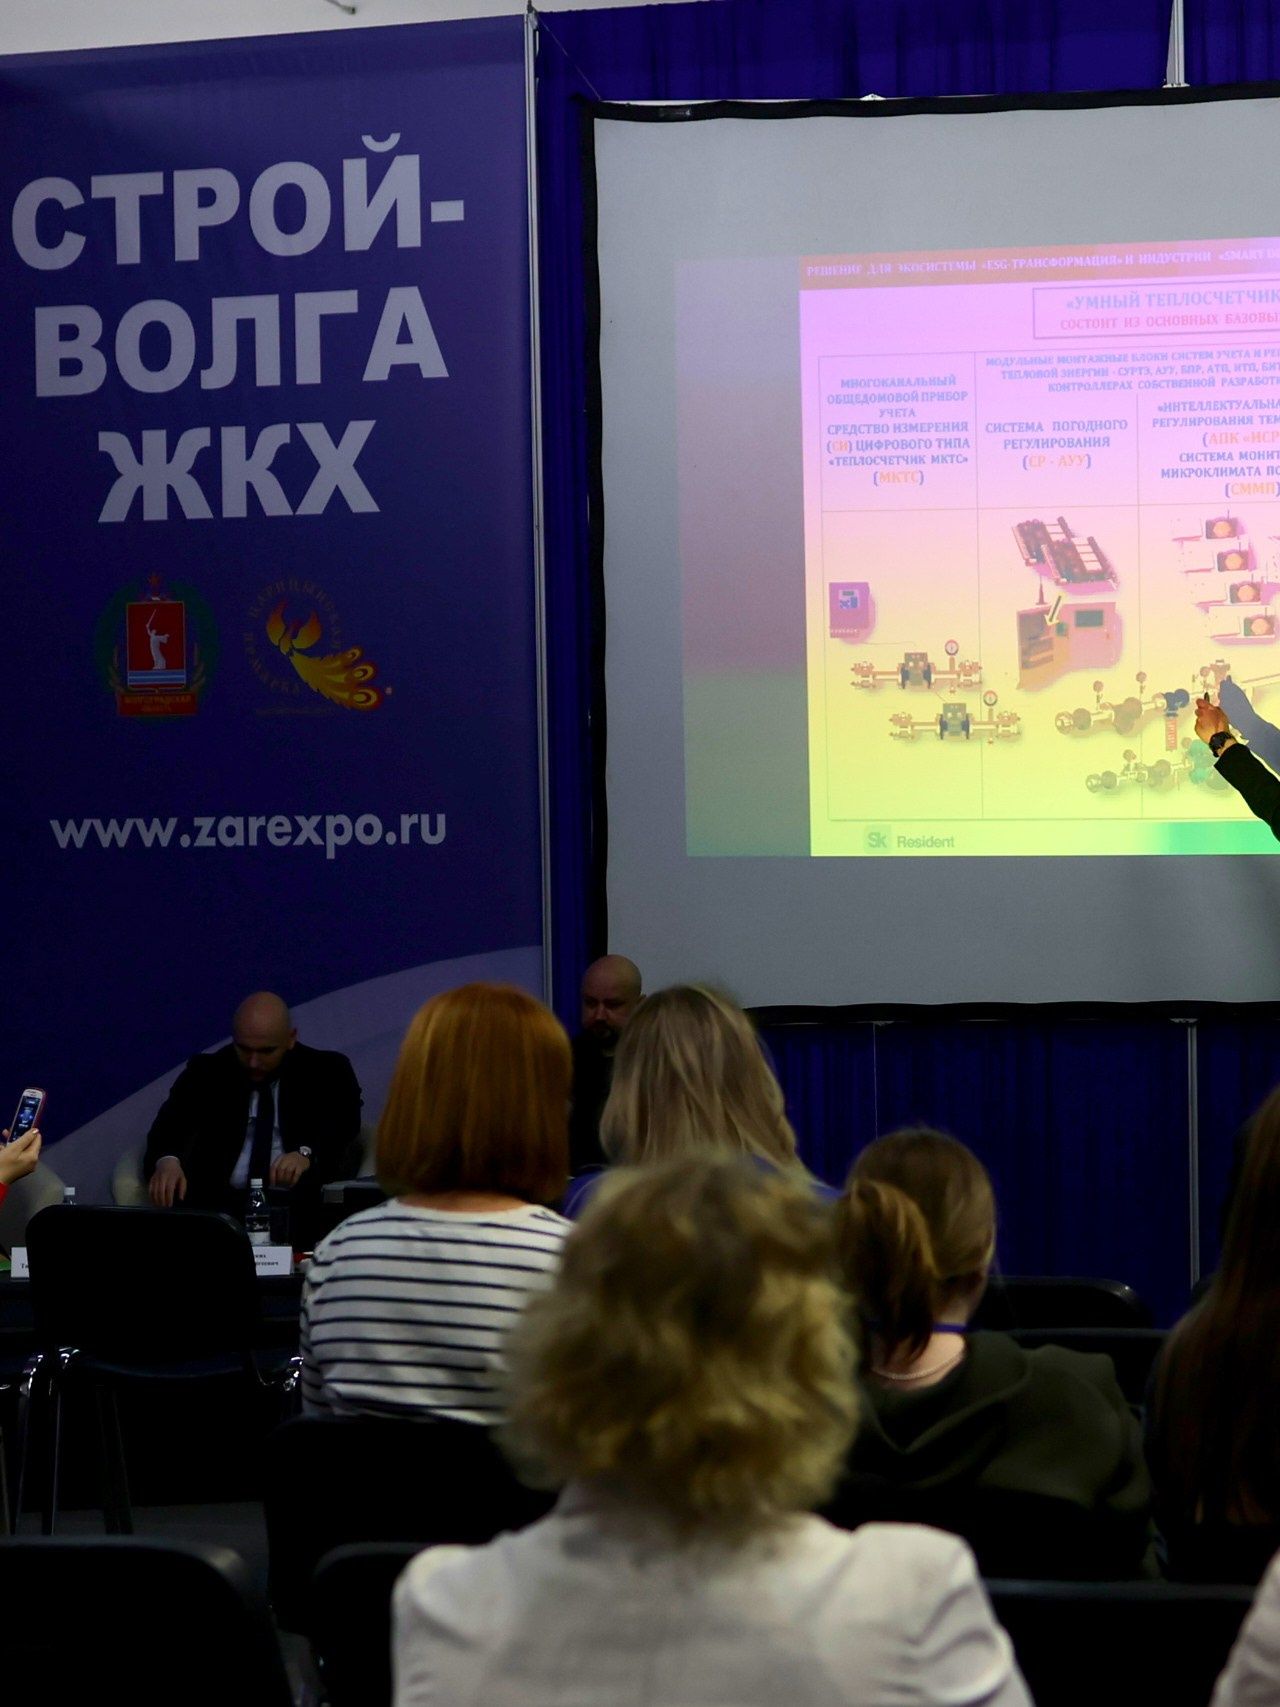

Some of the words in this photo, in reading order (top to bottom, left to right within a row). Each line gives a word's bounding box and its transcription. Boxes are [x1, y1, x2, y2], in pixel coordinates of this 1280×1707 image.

[11, 132, 465, 271] СТРОЙ-
[1139, 252, 1212, 265] ИНДУСТРИИ
[1066, 290, 1141, 310] «УМНЫЙ
[1060, 318, 1119, 330] СОСТОИТ
[1124, 317, 1141, 328] ИЗ
[1146, 314, 1219, 328] ОСНОВНЫХ
[34, 286, 450, 398] ВОЛГА
[986, 355, 1054, 367] МОДУЛЬНЫЕ
[1057, 353, 1128, 364] МОНТАЖНЫЕ
[1131, 352, 1168, 362] БЛОКИ
[1171, 351, 1214, 361] СИСТЕМ
[1216, 349, 1250, 360] УЧЕТА
[1253, 349, 1262, 358] И
[1001, 367, 1058, 380] ТЕПЛОВОЙ
[1061, 367, 1109, 379] ЭНЕРГИИ
[841, 374, 956, 389] МНОГОКАНАЛЬНЫЙ
[1048, 380, 1133, 393] КОНТРОЛЛЕРАХ
[1138, 376, 1216, 390] СОБСТВЕННОЙ
[827, 390, 919, 405] ОБЩЕДОМОВОЙ
[921, 391, 969, 402] ПРИБОР
[879, 408, 916, 418] УЧЕТА
[827, 423, 889, 436] СРЕДСТВО
[893, 421, 969, 433] ИЗМЕРЕНИЯ
[985, 421, 1044, 433] СИСТЕМА
[1052, 419, 1129, 432] ПОГОДНОГО
[1152, 415, 1254, 428] РЕГУЛИРОВАНИЯ
[855, 438, 933, 452] ЦИФРОВОГО
[936, 437, 970, 449] ТИПА
[1003, 436, 1111, 450] РЕГУЛИРОВАНИЯ
[829, 455, 926, 466] «ТЕПЛОСЧЕТЧИК
[931, 453, 969, 465] МКТС»
[1179, 451, 1234, 463] СИСТЕМА
[98, 420, 381, 523] ЖКХ
[873, 469, 925, 487] (МКТС)
[1161, 466, 1262, 479] МИКРОКЛИМАТА
[49, 813, 447, 860] www.zarexpo.ru
[866, 831, 888, 849] Sk
[896, 835, 955, 849] Resident
